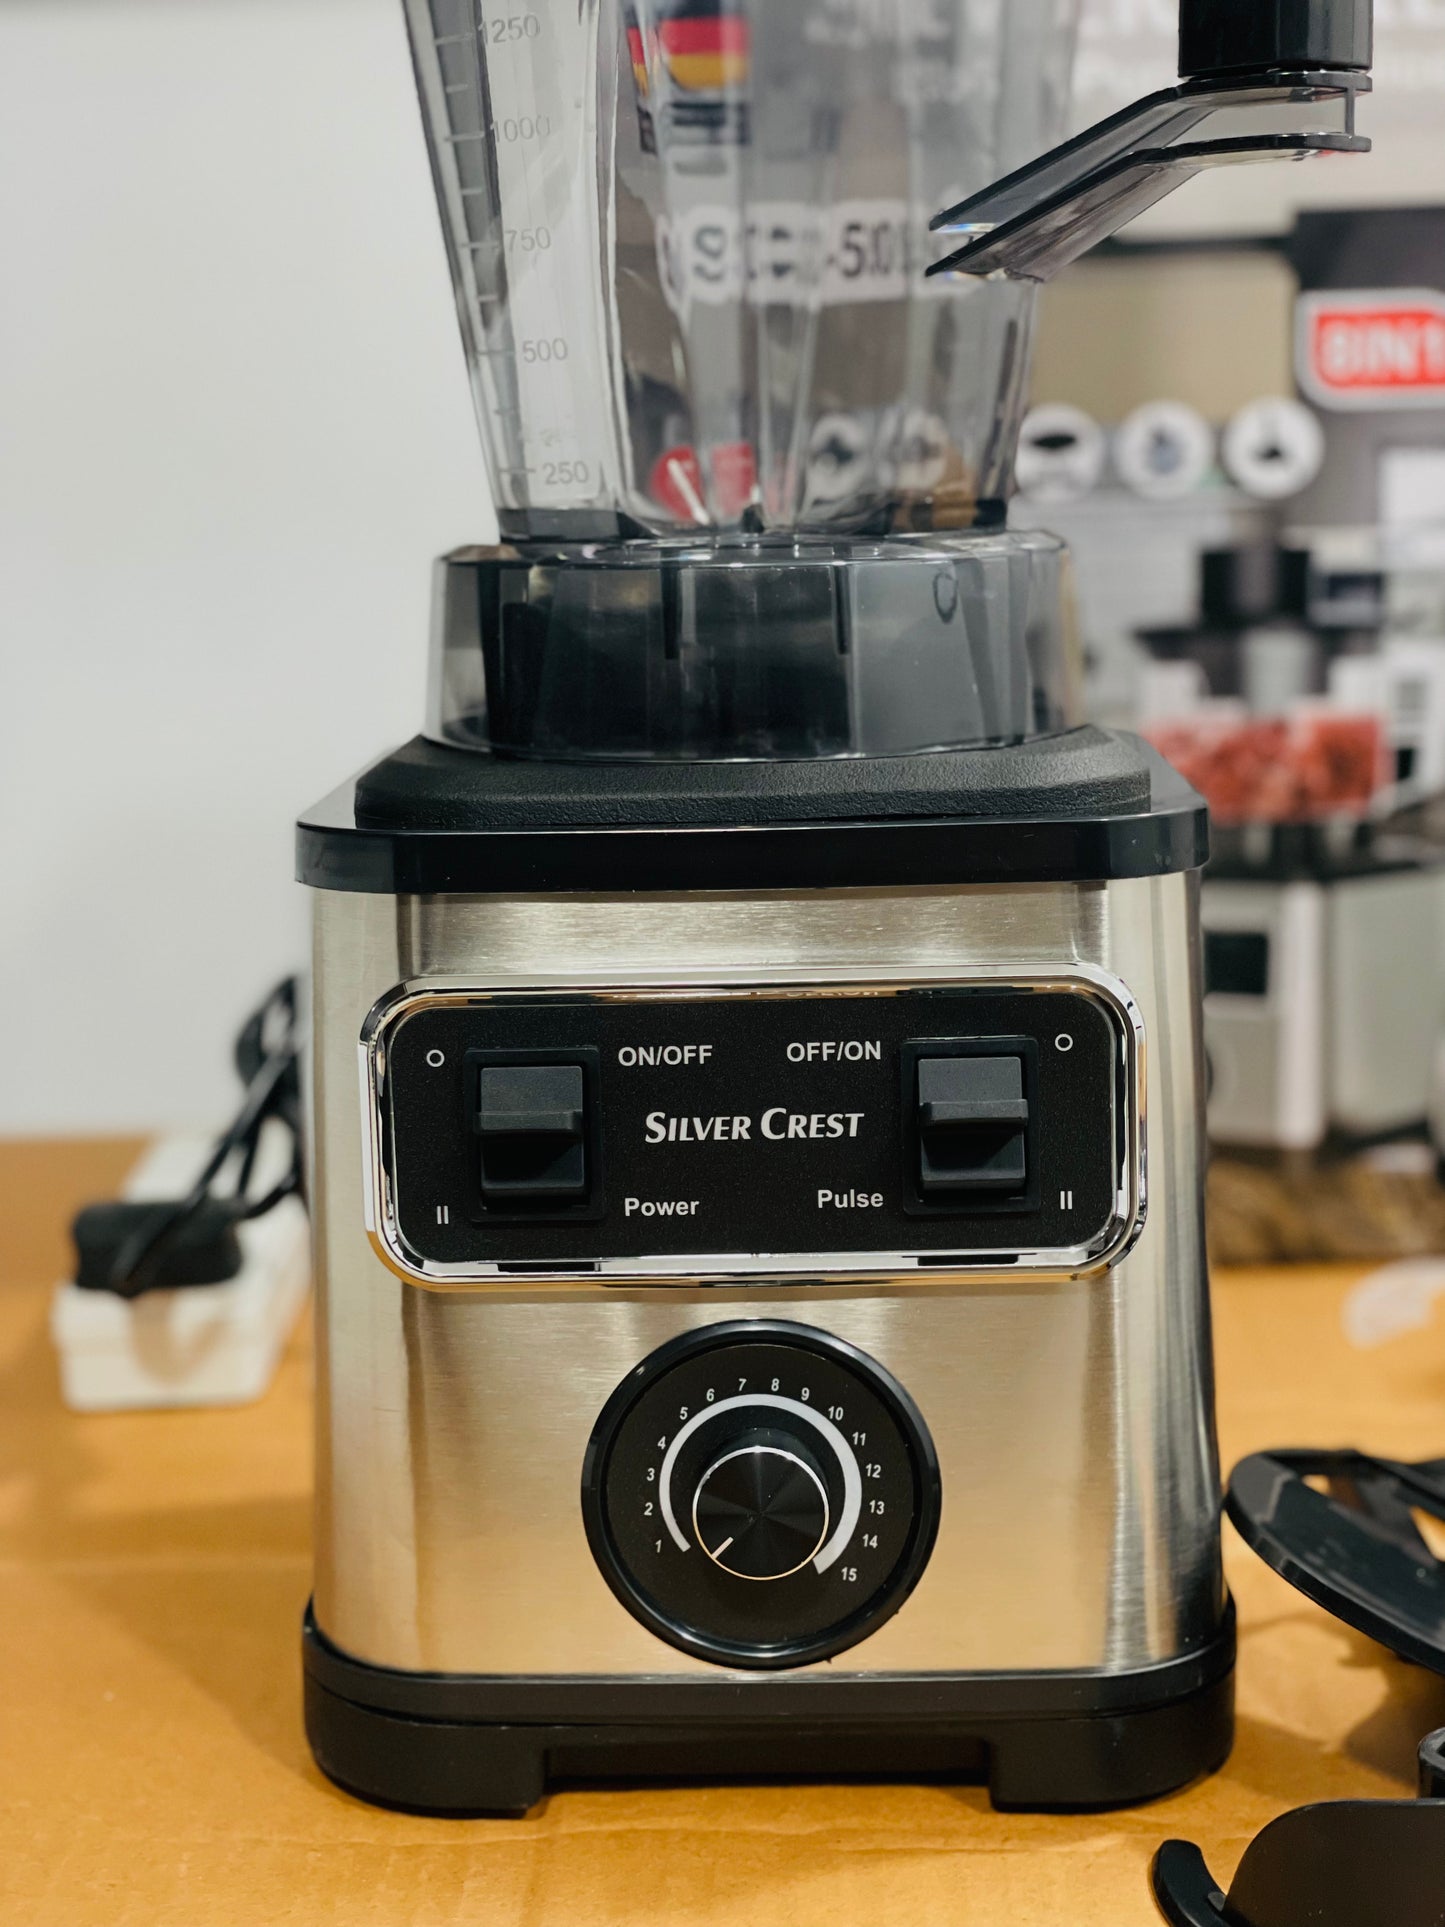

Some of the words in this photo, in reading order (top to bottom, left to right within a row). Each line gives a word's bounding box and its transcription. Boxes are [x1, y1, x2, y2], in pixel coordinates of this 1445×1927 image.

[483, 14, 541, 45] 1250
[493, 116, 551, 142] 1000
[504, 227, 551, 252] 750
[522, 338, 568, 363] 500
[542, 461, 589, 485] 250
[618, 1044, 713, 1067] ON/OFF
[786, 1040, 881, 1062] OFF/ON
[817, 1188, 884, 1209] Pulse
[624, 1197, 700, 1217] Power
[738, 1378, 747, 1392] 7
[771, 1377, 780, 1392] 8
[706, 1388, 715, 1402] 6
[801, 1387, 810, 1401] 9
[679, 1406, 689, 1421] 5
[828, 1406, 844, 1421] 10
[657, 1435, 667, 1450] 4
[852, 1432, 867, 1446] 11
[646, 1467, 655, 1482] 3
[865, 1463, 882, 1479] 12
[643, 1501, 653, 1516] 2
[869, 1499, 885, 1515] 13
[655, 1539, 662, 1553] 1
[862, 1533, 878, 1549] 14
[841, 1566, 858, 1582] 15
